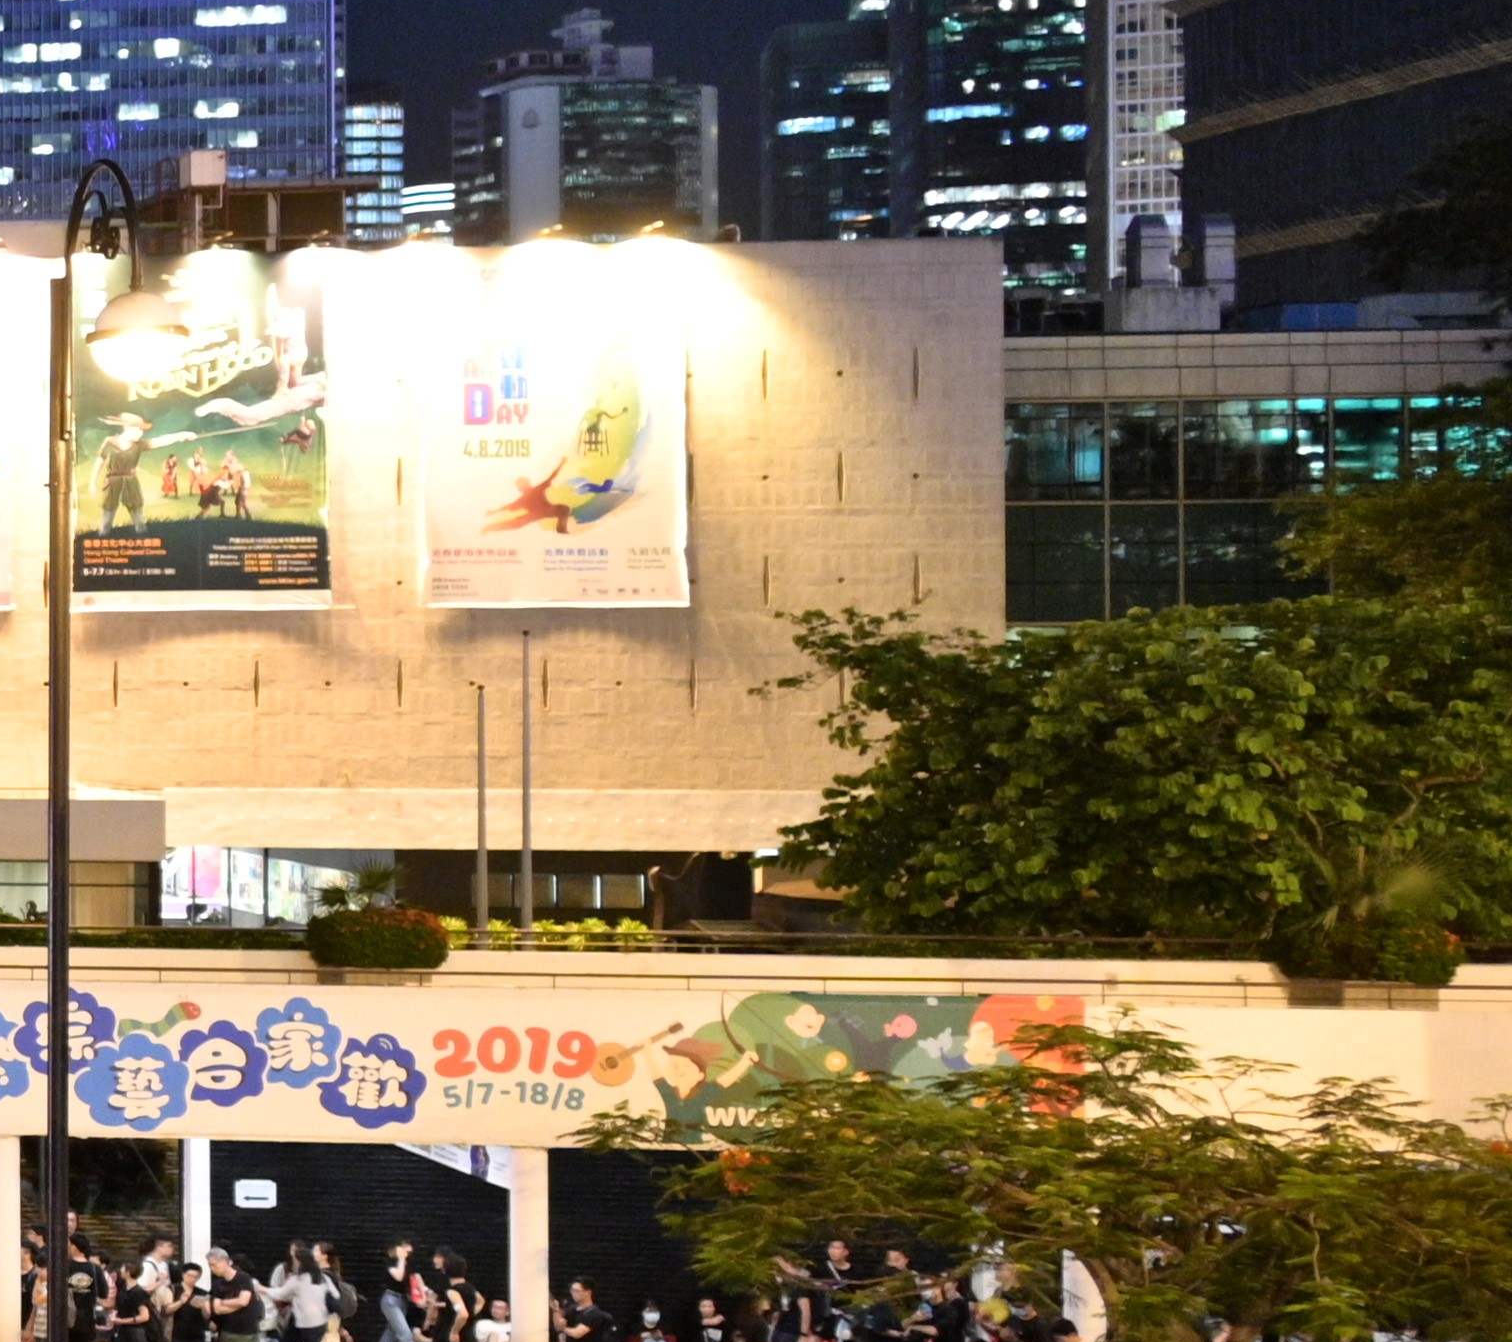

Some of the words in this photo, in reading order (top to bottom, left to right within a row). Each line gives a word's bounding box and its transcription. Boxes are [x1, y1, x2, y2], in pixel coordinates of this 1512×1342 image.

[464, 439, 530, 458] 4.8.2019
[432, 1026, 597, 1081] 2019
[444, 1077, 586, 1112] 5/7-18/8
